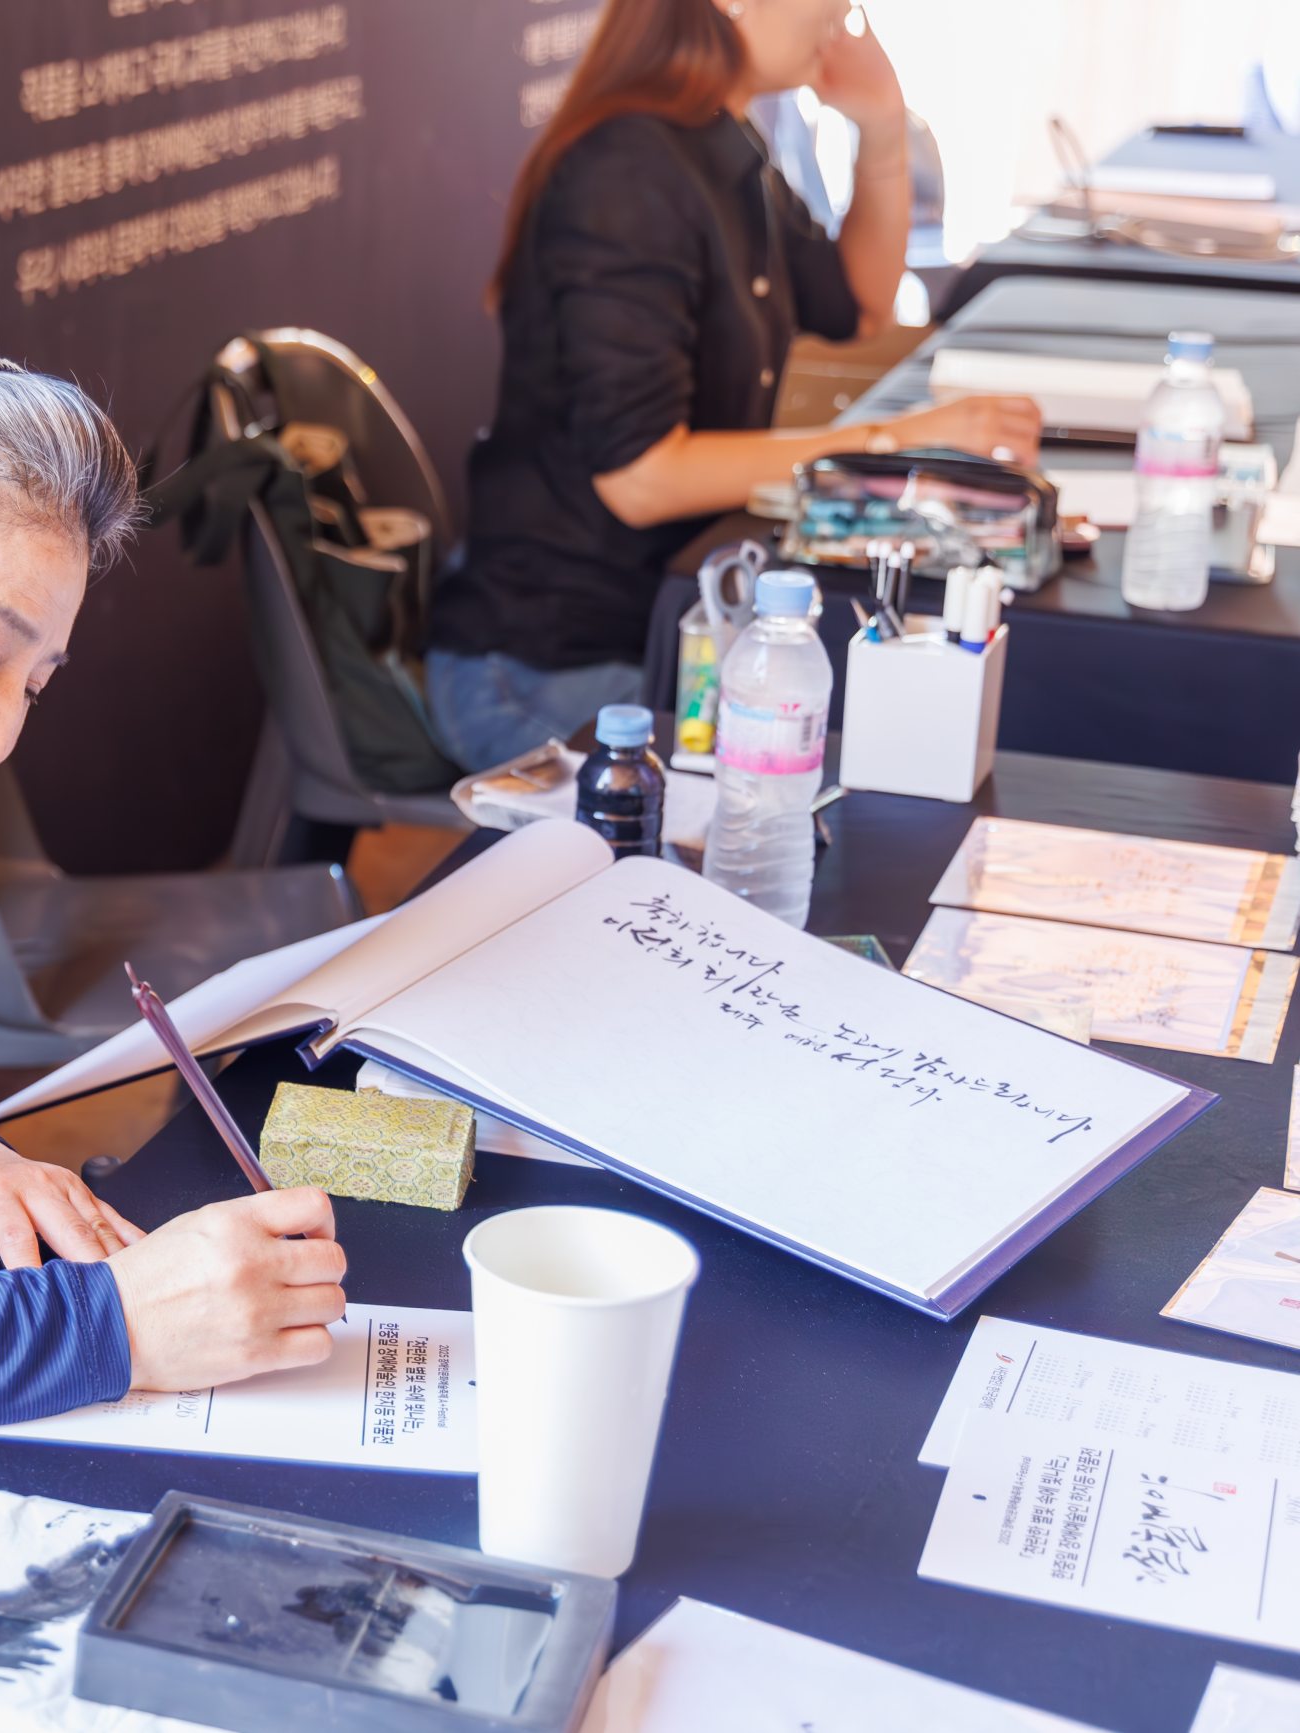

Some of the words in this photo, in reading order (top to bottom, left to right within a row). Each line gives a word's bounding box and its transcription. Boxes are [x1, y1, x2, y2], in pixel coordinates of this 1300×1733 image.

[377, 1323, 400, 1347] 한중일
[438, 1344, 450, 1358] 2025
[375, 1347, 399, 1389] 장애예술인
[405, 1366, 428, 1383] 별빛
[374, 1391, 397, 1416] 한지등
[404, 1385, 426, 1402] 속에
[372, 1418, 395, 1445] 작품전
[1075, 1447, 1102, 1473] 작품전
[1035, 1485, 1061, 1505] 속에
[1068, 1474, 1096, 1503] 한지등
[1030, 1504, 1056, 1526] 별빛
[1056, 1503, 1090, 1550] 장애예술인
[1050, 1549, 1079, 1580] 한중일
